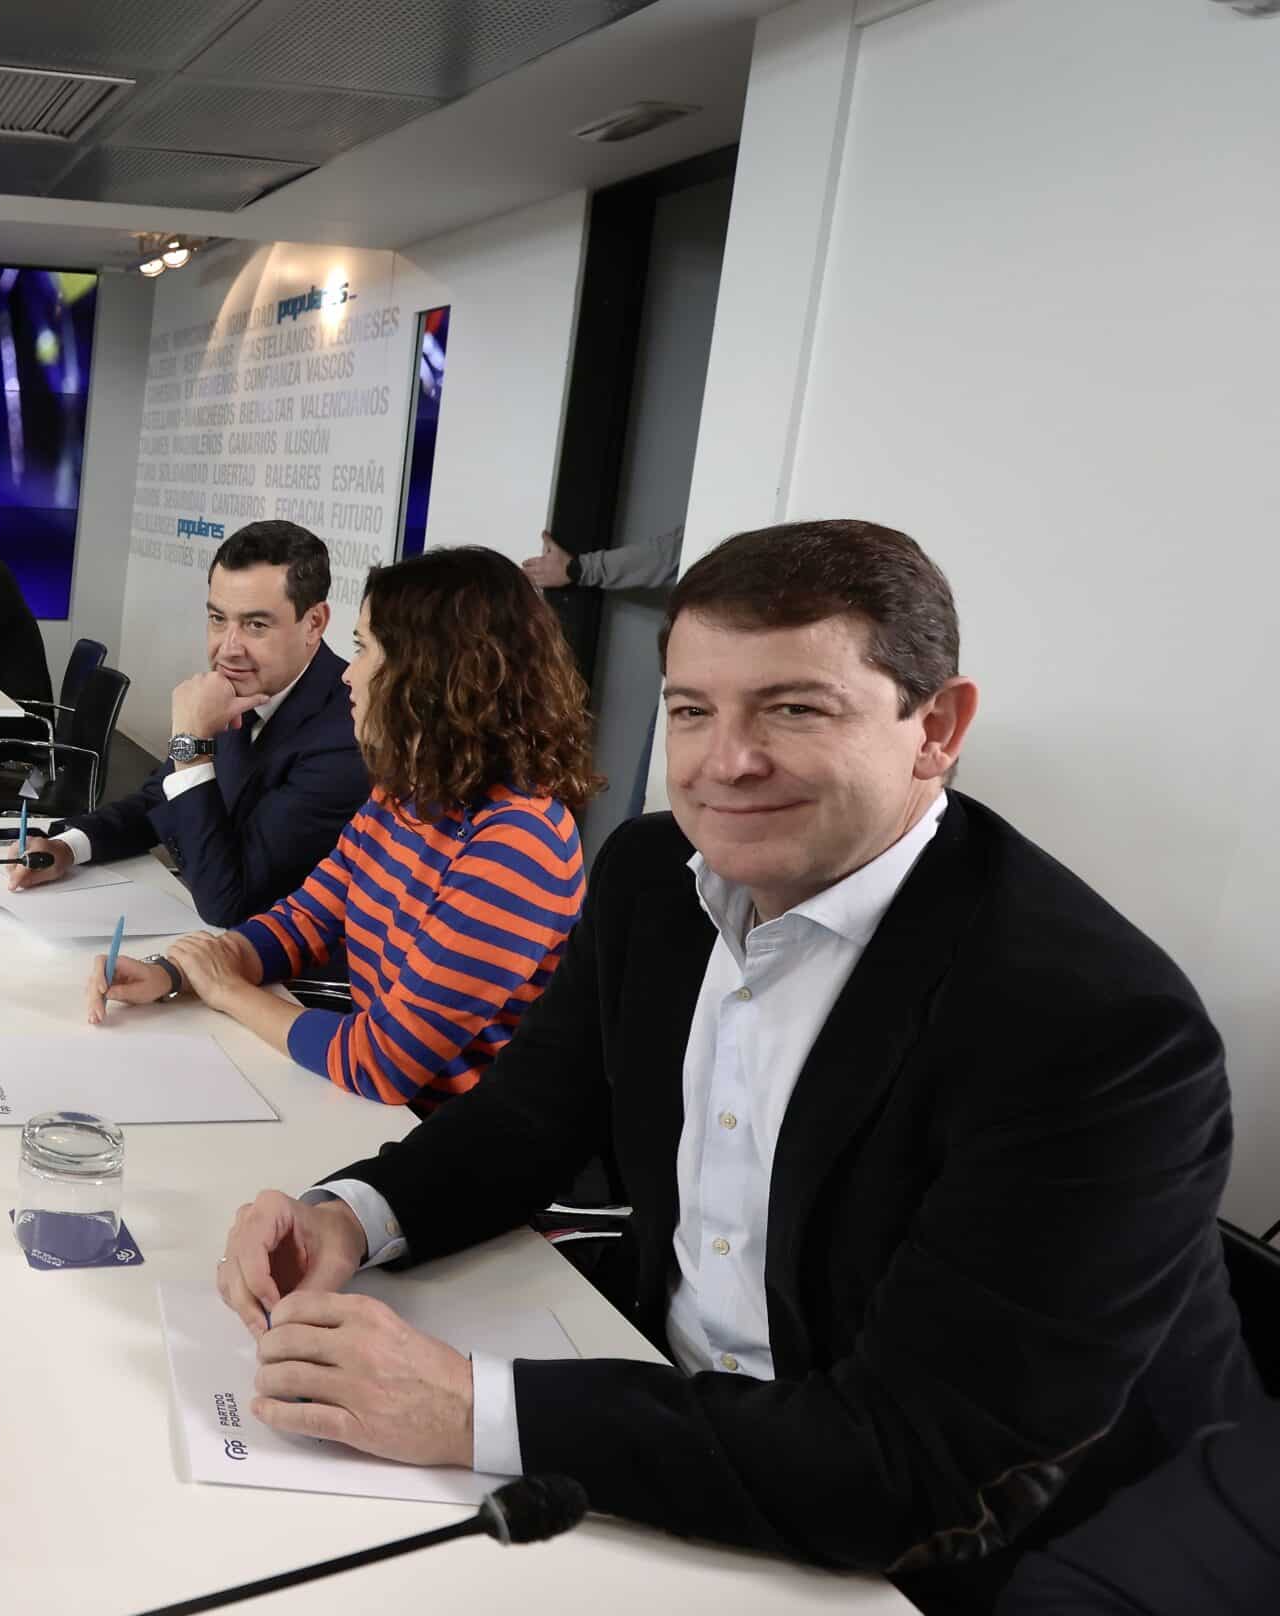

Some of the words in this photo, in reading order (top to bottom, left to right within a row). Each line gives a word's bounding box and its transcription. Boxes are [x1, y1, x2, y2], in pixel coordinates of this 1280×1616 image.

[243, 360, 301, 391] CONFIANZA
[306, 351, 355, 384] VASCOS
[239, 396, 294, 424] BIENESTAR
[300, 385, 390, 420] VALENCIANOS
[228, 430, 277, 456] CANARIOS
[284, 424, 331, 457] ILUSIÓN
[213, 463, 256, 488] LIBERTAD
[265, 463, 321, 491] BALEARES
[331, 458, 385, 495] ESPAÑA
[177, 516, 225, 540] populares
[275, 497, 324, 527] EFICACIA
[331, 502, 383, 534] FUTURO
[214, 1393, 230, 1427] PARTIDO
[225, 1392, 241, 1428] POPULAR
